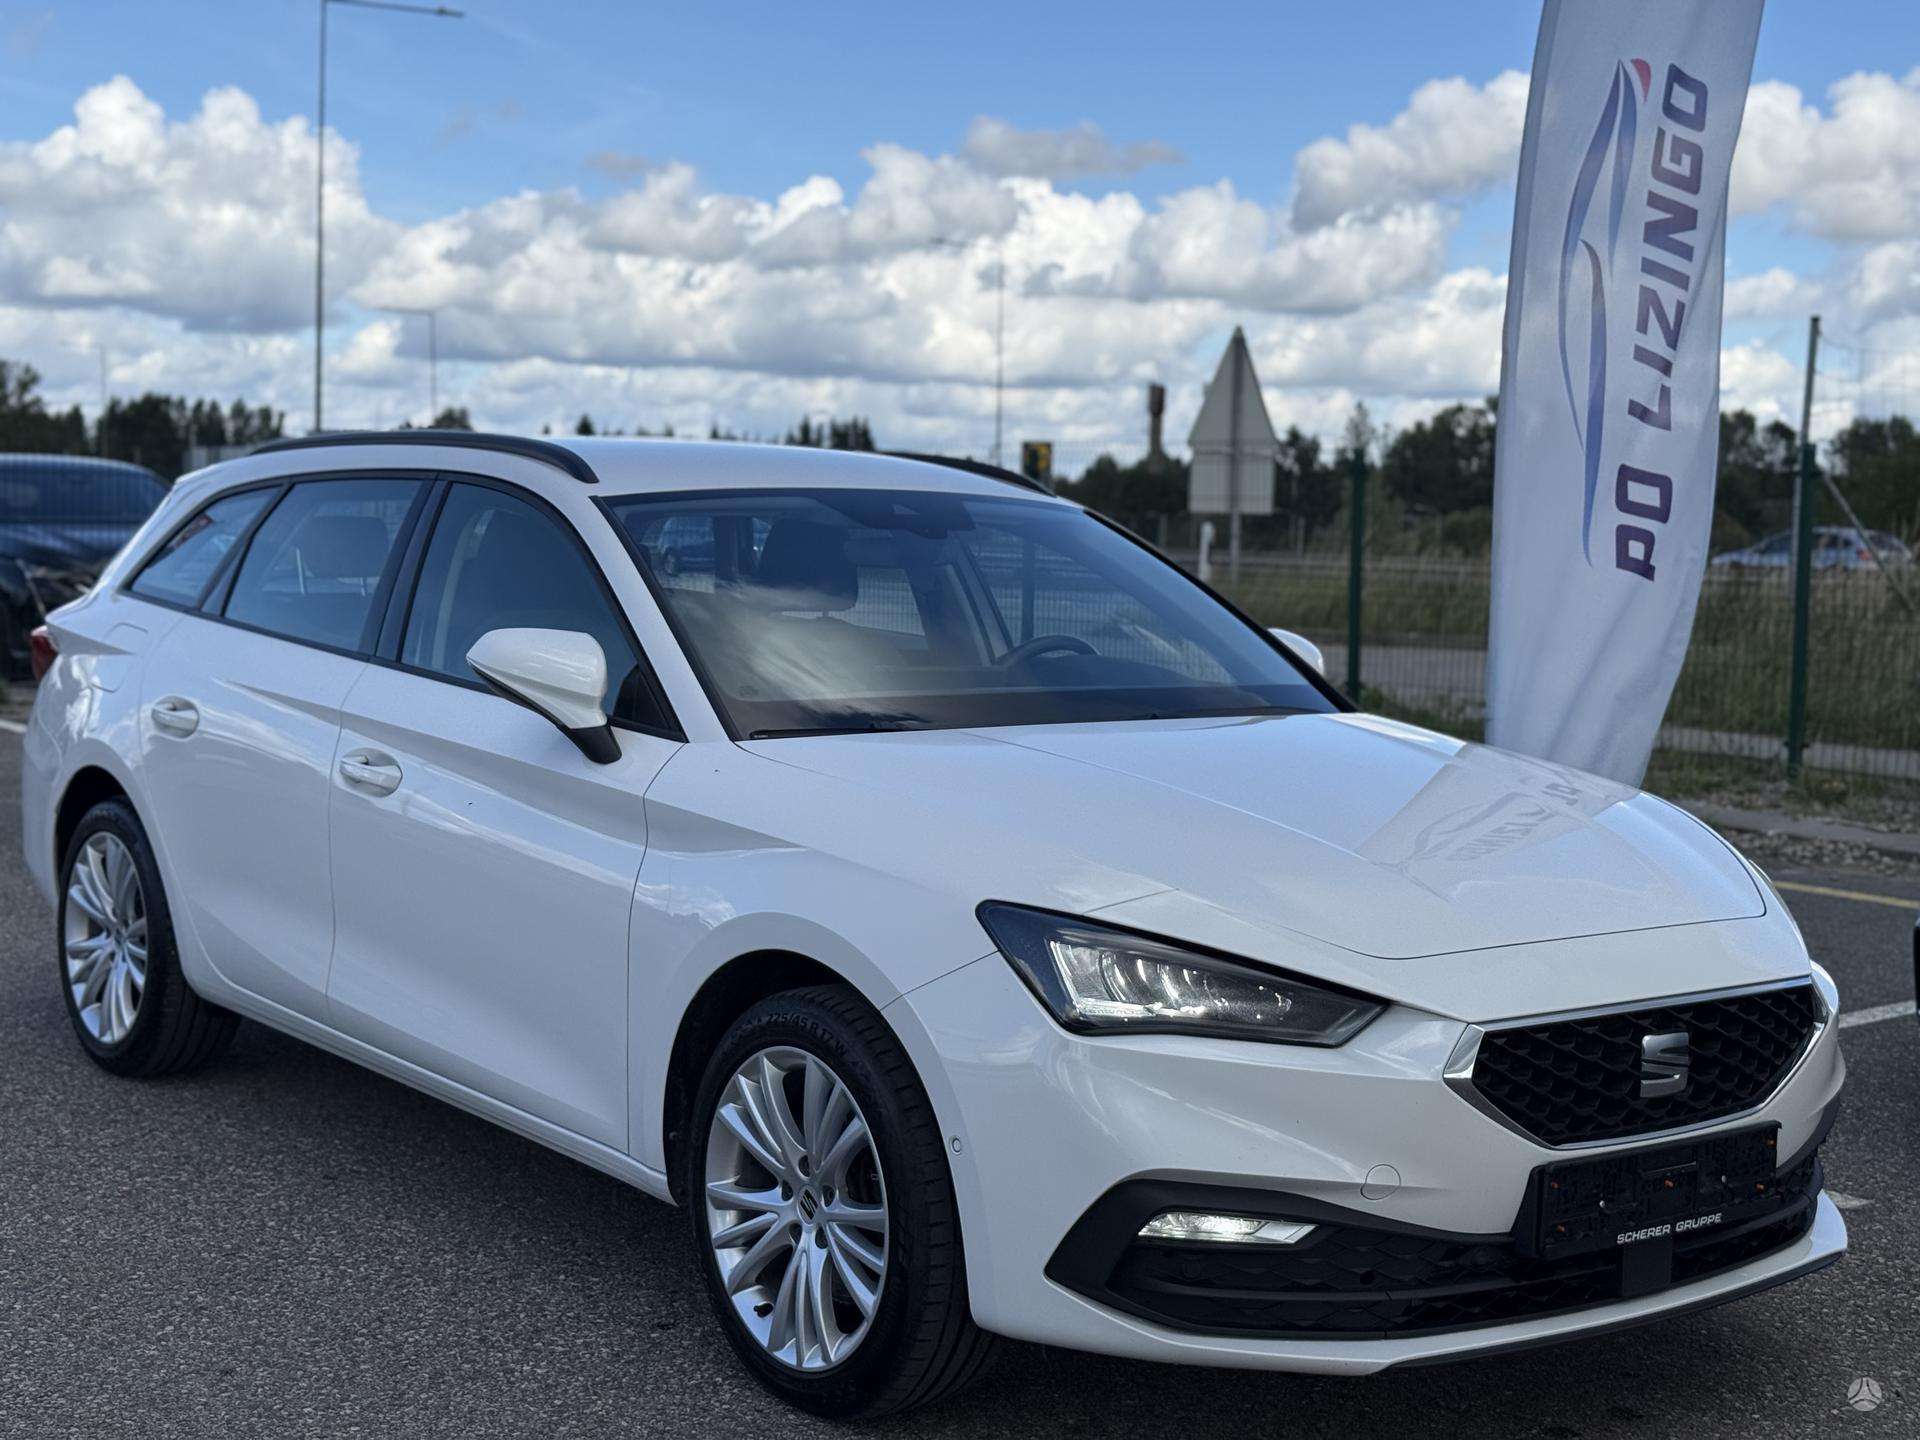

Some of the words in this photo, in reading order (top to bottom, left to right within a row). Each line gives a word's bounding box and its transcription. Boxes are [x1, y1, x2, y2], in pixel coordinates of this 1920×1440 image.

[1628, 62, 1708, 431] LIZINGO
[1615, 463, 1673, 582] PO
[1617, 1224, 1671, 1244] SCHERER
[1675, 1212, 1722, 1232] GRUPPE
